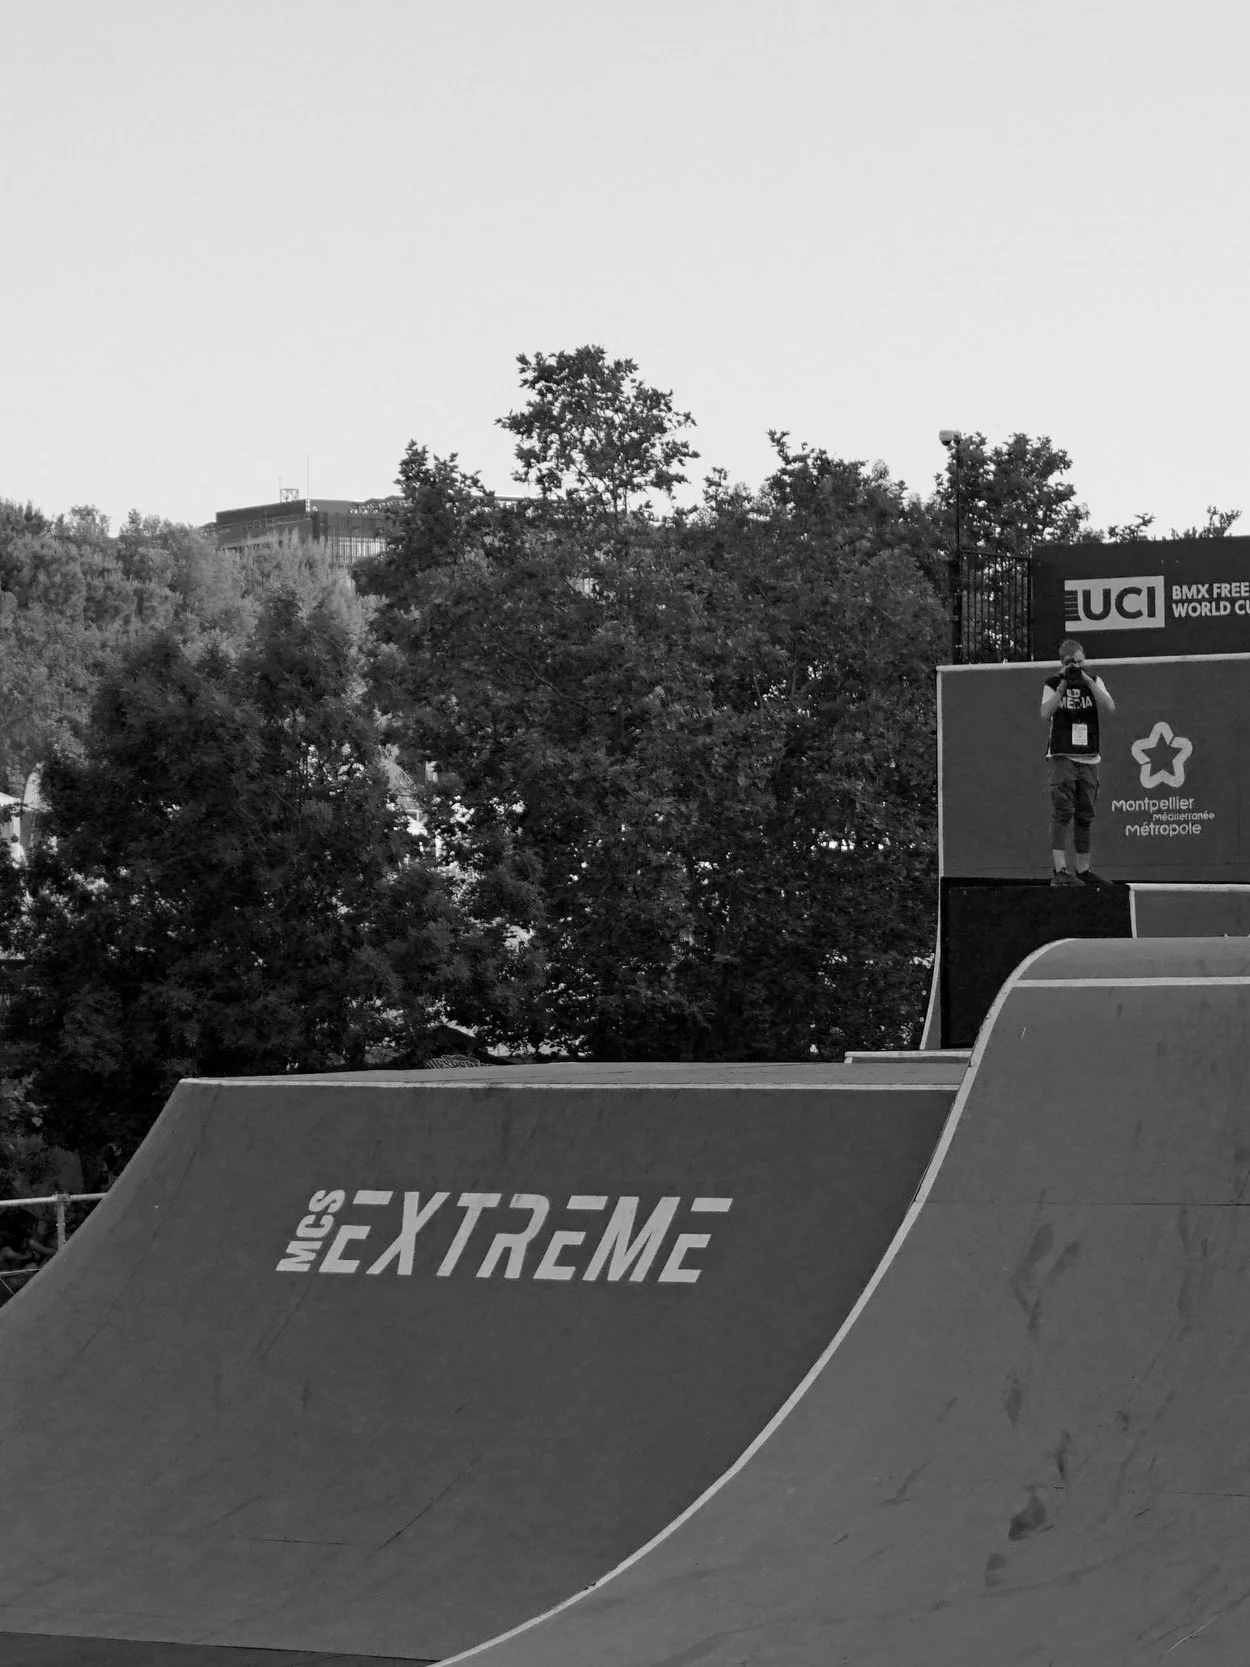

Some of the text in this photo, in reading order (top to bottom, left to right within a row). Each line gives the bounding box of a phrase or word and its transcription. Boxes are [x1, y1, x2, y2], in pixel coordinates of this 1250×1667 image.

[1082, 586, 1156, 621] UCI
[1172, 583, 1209, 600] BMX
[1172, 600, 1231, 618] WORLD
[275, 1189, 346, 1273] MCS
[318, 1190, 734, 1284] EXTREME
